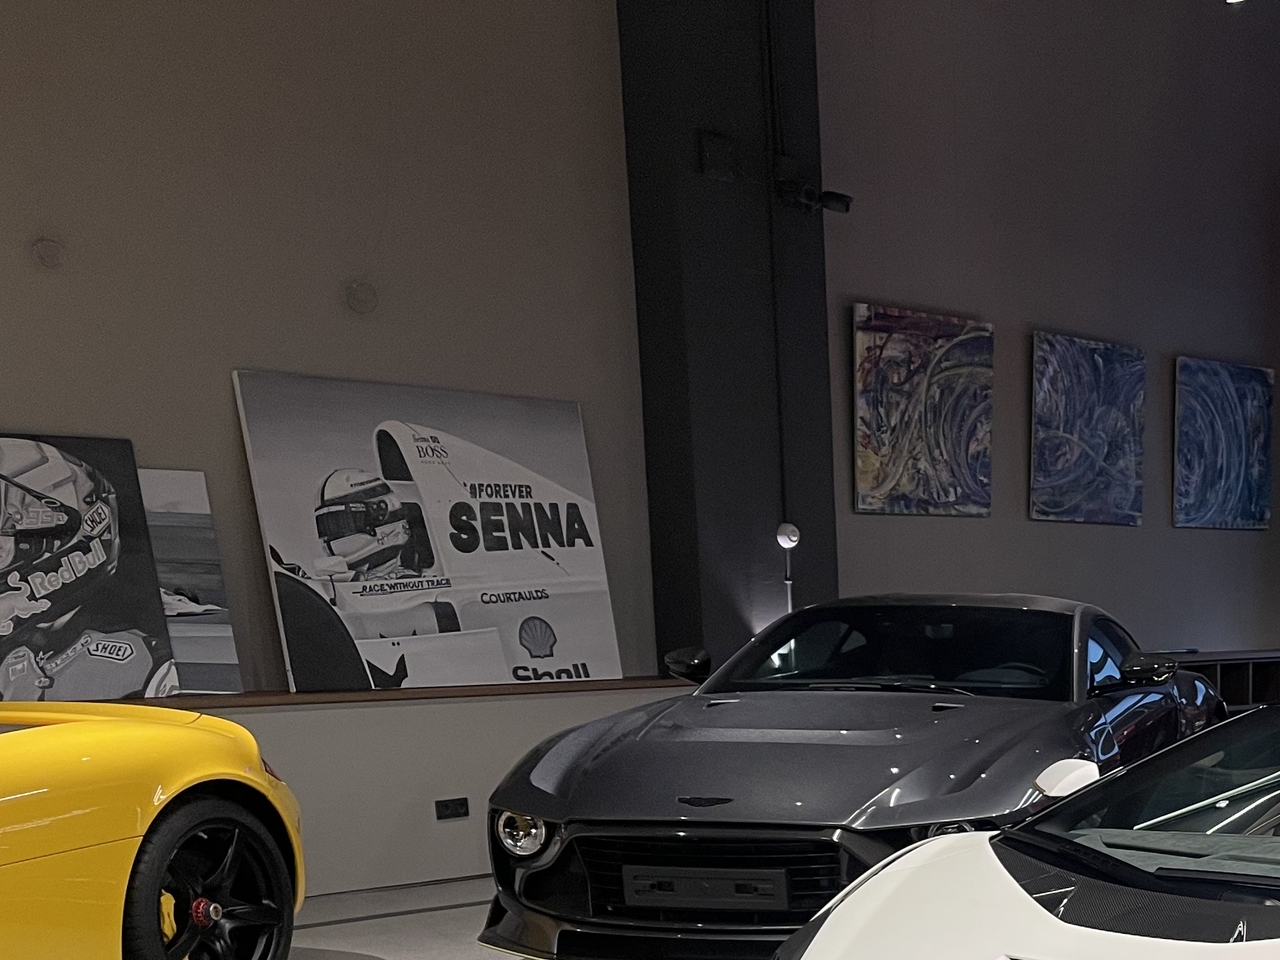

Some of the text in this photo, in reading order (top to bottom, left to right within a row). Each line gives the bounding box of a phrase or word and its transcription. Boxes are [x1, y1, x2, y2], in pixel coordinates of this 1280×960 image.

[416, 445, 449, 458] BOSS
[85, 505, 107, 532] SHOEI
[449, 501, 595, 553] SENNA
[361, 577, 452, 594] RACE WITHOUT TRACE
[480, 588, 549, 604] COURTAULDS
[92, 642, 128, 658] SHOEI
